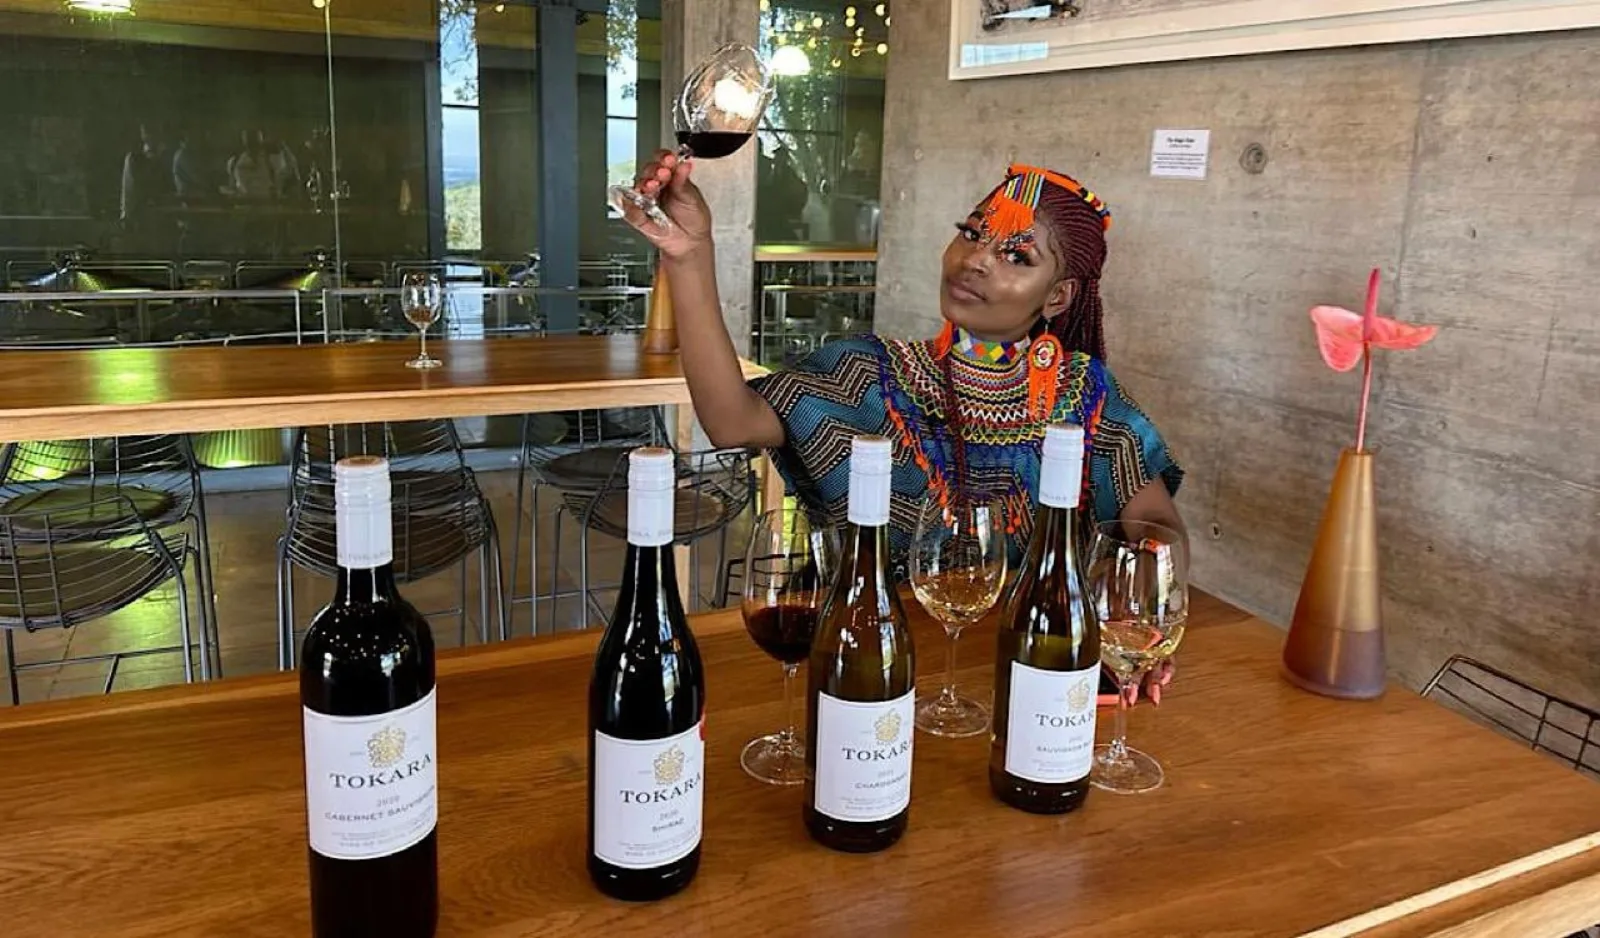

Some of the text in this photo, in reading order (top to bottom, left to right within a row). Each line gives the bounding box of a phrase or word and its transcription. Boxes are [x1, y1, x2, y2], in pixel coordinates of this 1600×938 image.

[329, 753, 432, 789] TOKARA
[619, 771, 701, 804] TOKARA
[324, 811, 384, 822] CABERNET
